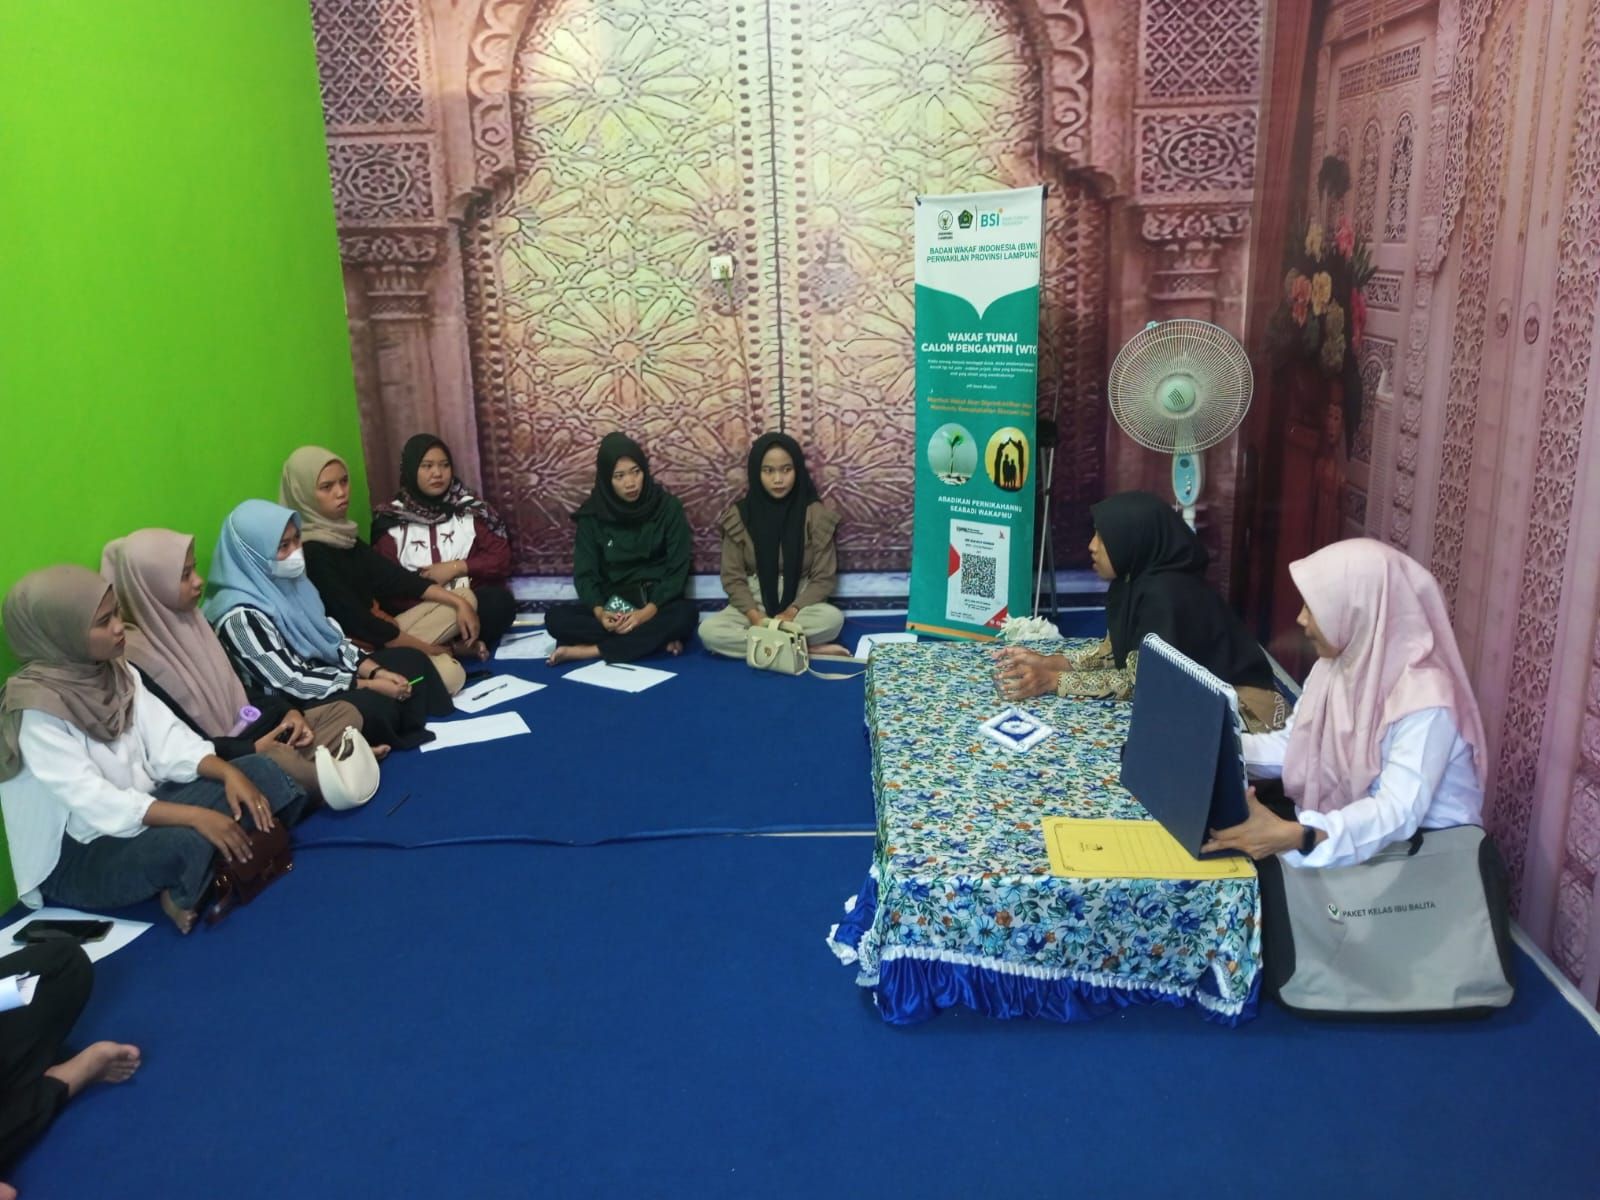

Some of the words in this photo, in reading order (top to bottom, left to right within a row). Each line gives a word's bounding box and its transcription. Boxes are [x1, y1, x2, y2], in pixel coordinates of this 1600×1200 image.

[981, 213, 1000, 228] BSI
[929, 246, 953, 255] BADAN
[954, 245, 977, 254] WAKAF
[979, 243, 1017, 253] INDONESIA
[927, 254, 970, 263] PERWAKILAN
[971, 252, 1003, 262] PROVINSI
[947, 332, 983, 342] WAKAF
[985, 332, 1018, 343] TUNAI
[921, 343, 954, 352] CALON
[956, 343, 1013, 353] PENGANTIN
[938, 496, 971, 506] ABADIKAN
[978, 509, 1013, 519] WAKAFMU
[1342, 908, 1367, 918] PAKET
[1367, 906, 1393, 916] KELAS
[1394, 904, 1408, 913] IBU
[1408, 901, 1436, 911] BALITA
